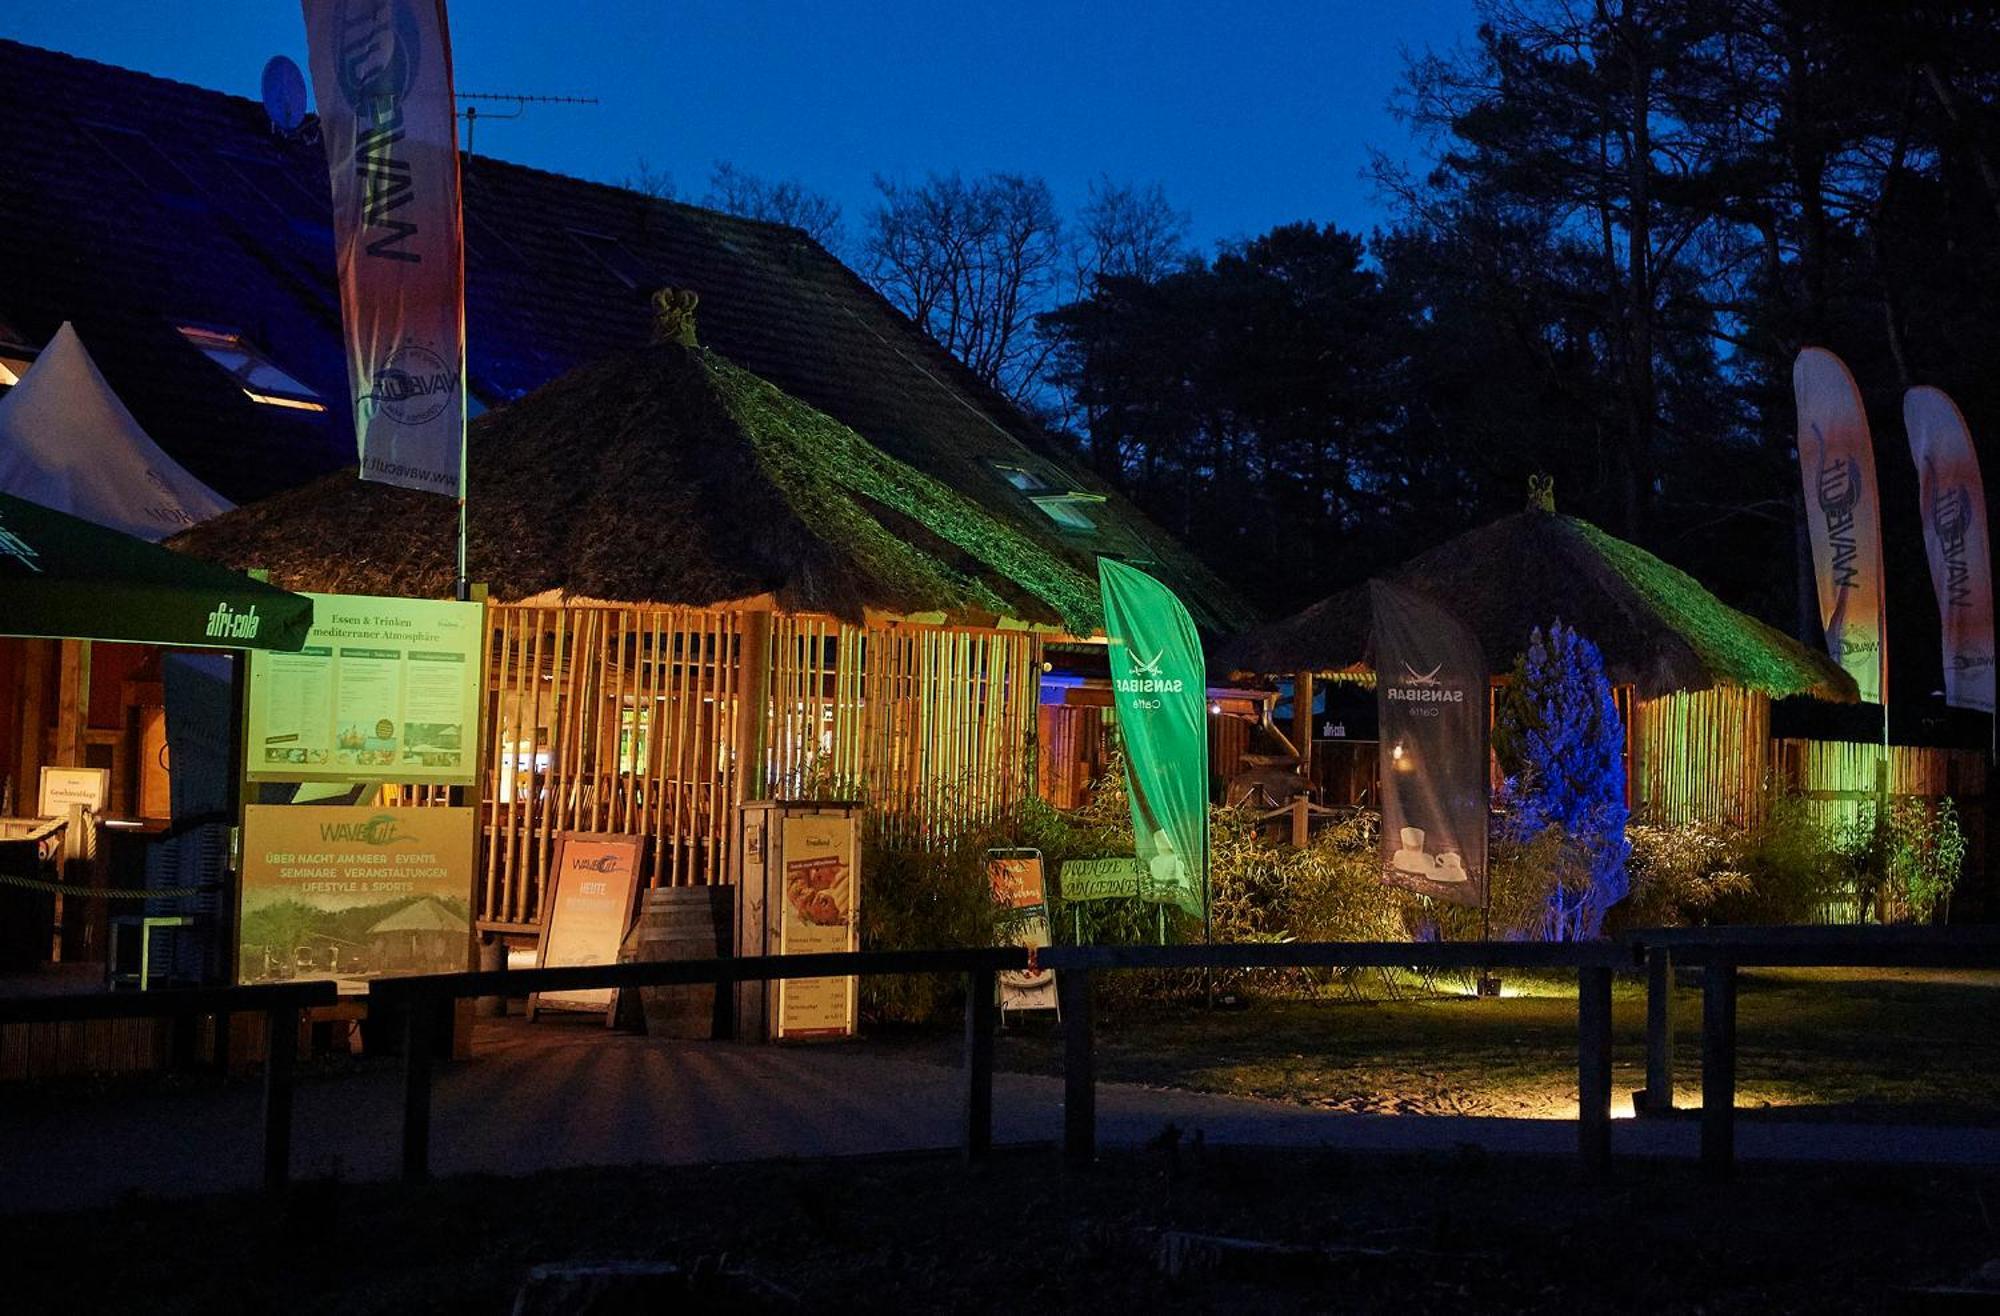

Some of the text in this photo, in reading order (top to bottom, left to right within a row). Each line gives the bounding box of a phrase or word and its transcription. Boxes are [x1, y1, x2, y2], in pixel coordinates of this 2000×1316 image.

[206, 602, 260, 639] afri-cola
[332, 614, 412, 627] Essen & Trinken
[313, 628, 440, 643] mediterraner Atmosphäre
[266, 852, 436, 864] ÜBER NACHT AM MEER EVENTS
[280, 867, 449, 878] SEMINARE VERANSTALTUNGEN
[302, 882, 414, 892] LIFESTYLE & SPORTS
